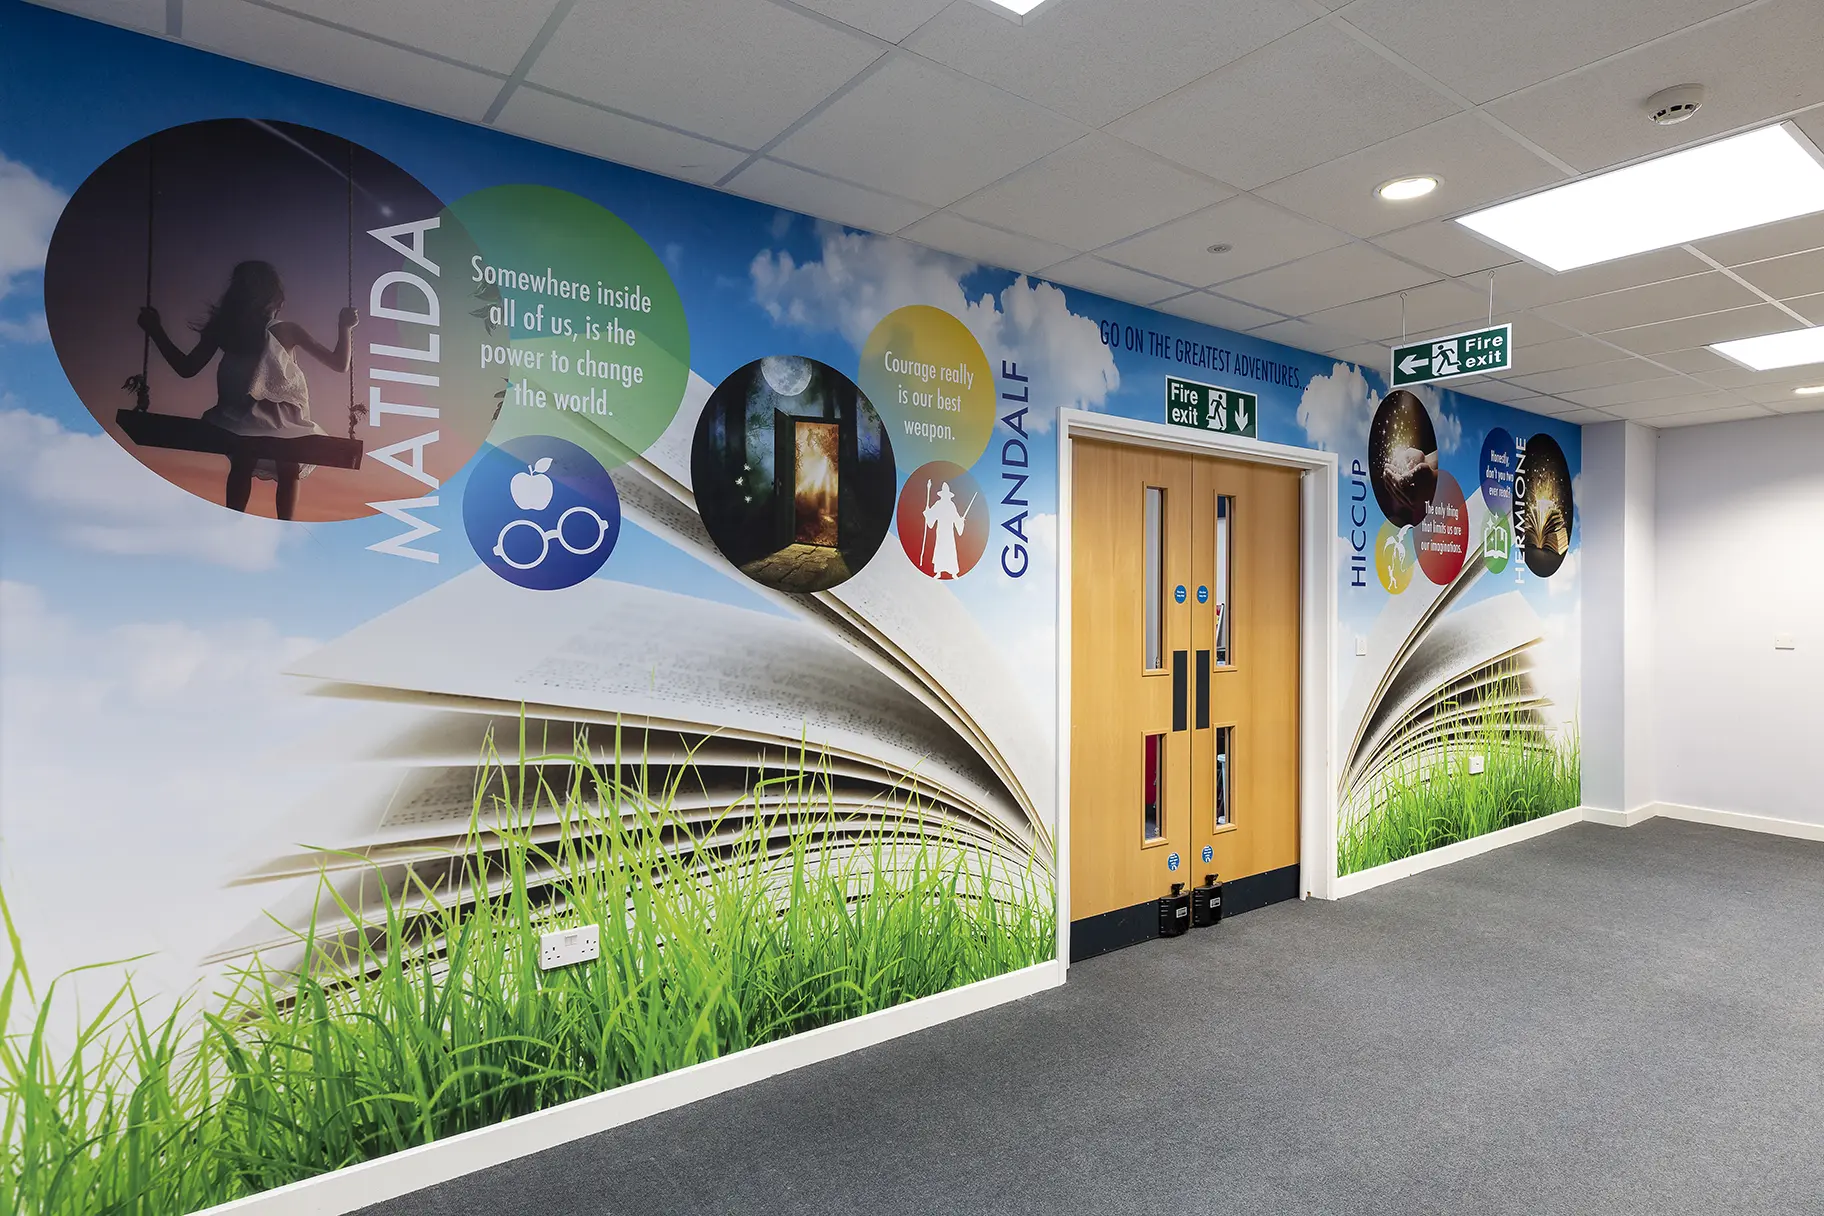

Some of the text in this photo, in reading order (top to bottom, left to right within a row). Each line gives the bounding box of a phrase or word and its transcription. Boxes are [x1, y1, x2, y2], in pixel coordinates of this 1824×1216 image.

[470, 254, 652, 314] Somewhere inside
[489, 299, 636, 346] all of us, is the
[1100, 319, 1309, 392] GO ON THE GREATEST ADVENTURES...
[1465, 335, 1504, 353] Fire
[1465, 350, 1502, 369] exit
[480, 341, 644, 388] power to change
[884, 350, 975, 390] Courage really
[365, 216, 441, 564] MATILDA
[514, 378, 614, 417] the world.
[898, 384, 962, 413] is our best
[1171, 382, 1199, 405] Fire
[904, 419, 956, 443] weapon.
[1171, 406, 1199, 426] exit
[1001, 360, 1029, 579] GANDALF
[1351, 458, 1367, 587] HICCUP
[1422, 519, 1432, 532] that
[1433, 520, 1446, 534] limits
[1447, 525, 1453, 535] us
[1425, 500, 1458, 520] The only thing
[1514, 436, 1527, 584] HERMIONE
[1421, 541, 1430, 551] our
